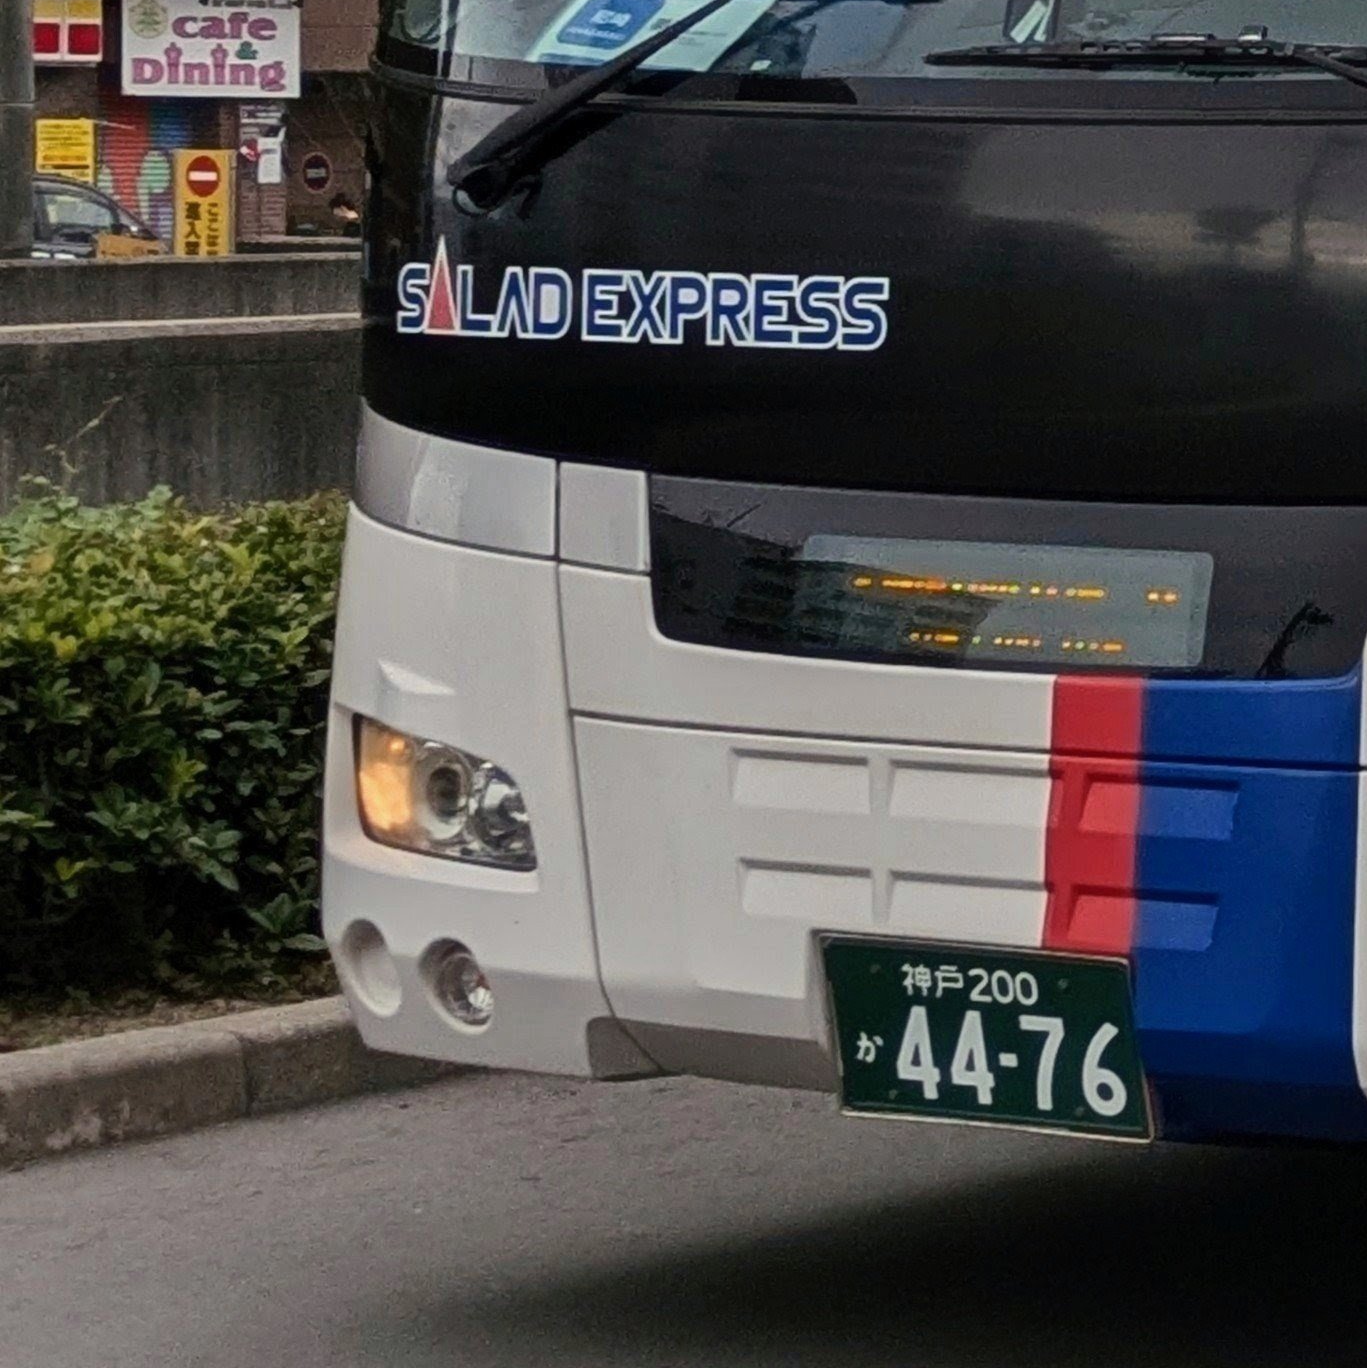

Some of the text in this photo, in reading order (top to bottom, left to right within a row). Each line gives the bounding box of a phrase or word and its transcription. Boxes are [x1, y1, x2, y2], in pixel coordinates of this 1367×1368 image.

[172, 10, 277, 41] cafe
[130, 42, 287, 92] Dining
[396, 234, 890, 351] SALAD EXPRESS
[855, 1005, 1128, 1117] か 44-76
